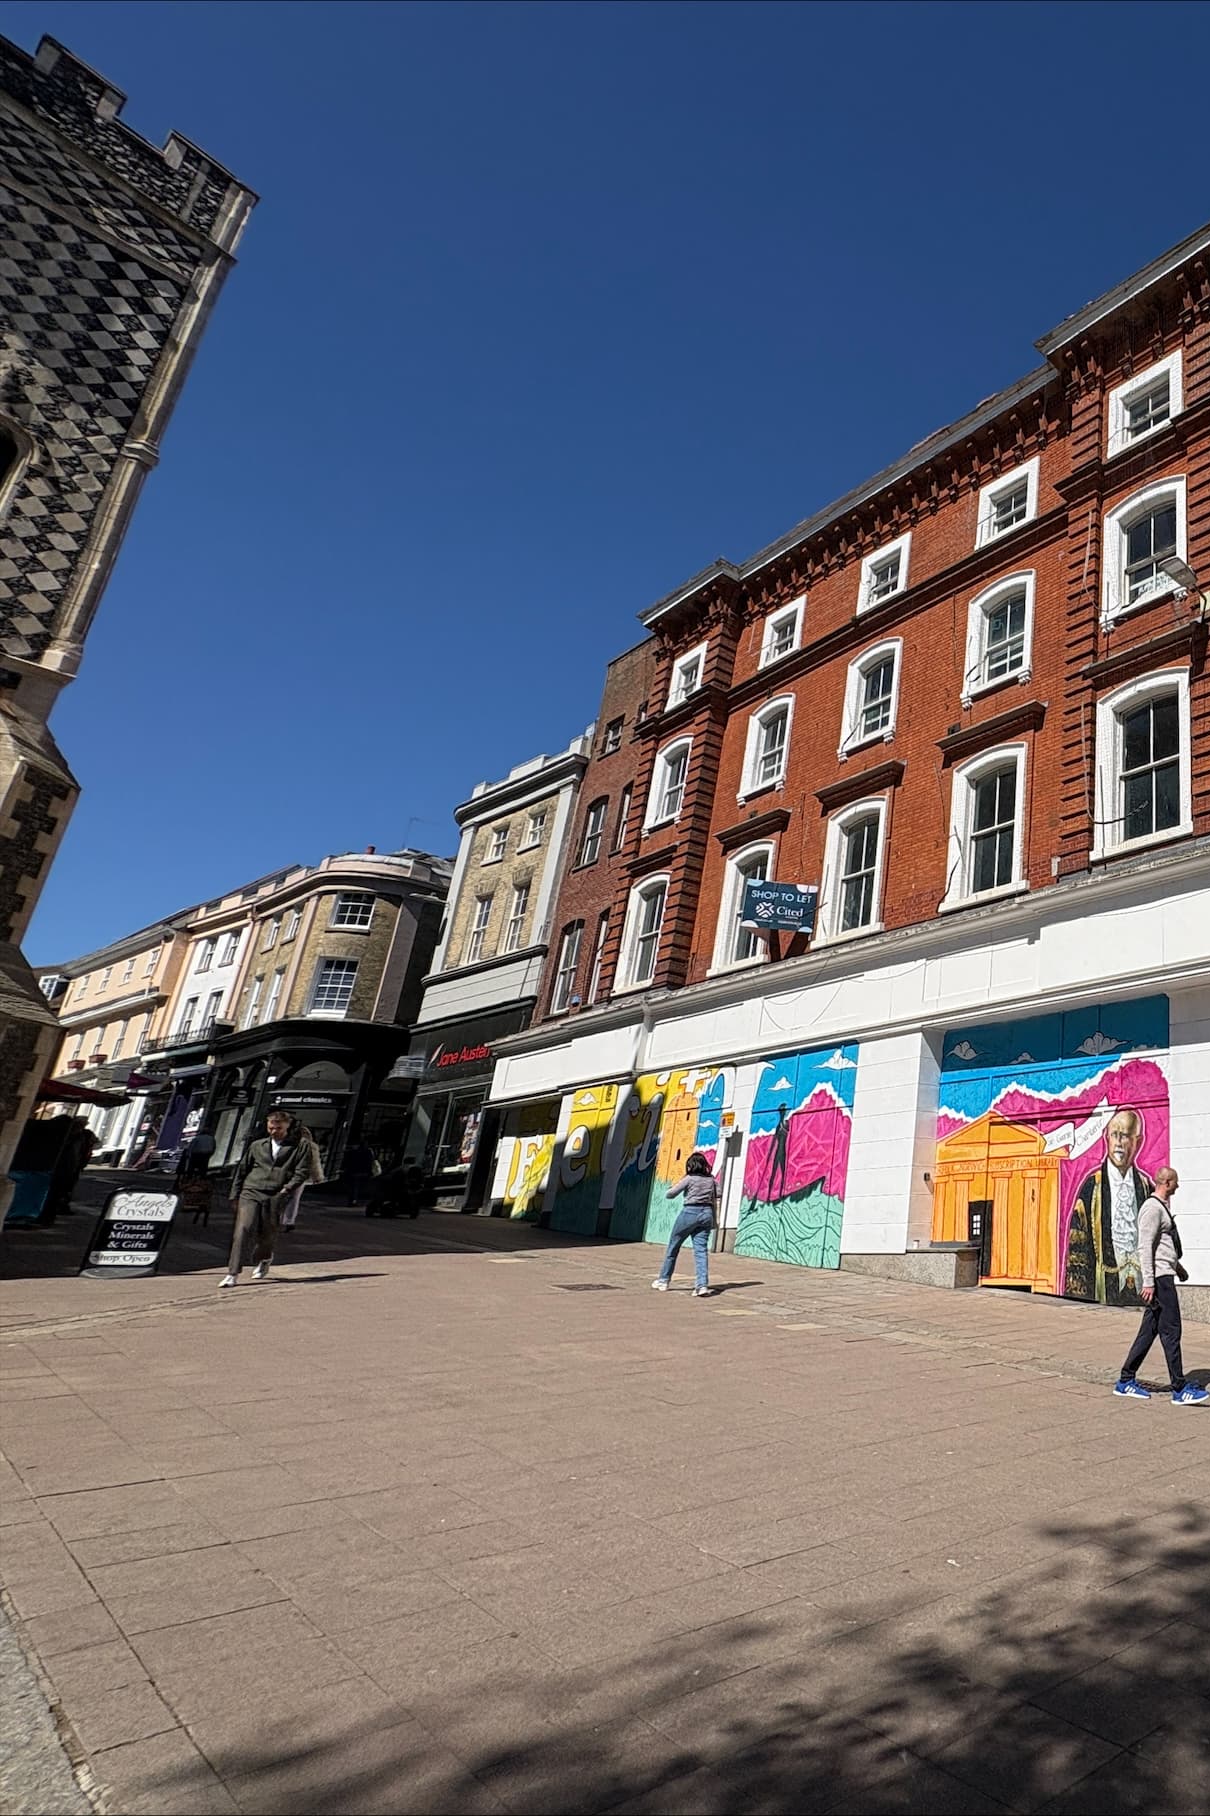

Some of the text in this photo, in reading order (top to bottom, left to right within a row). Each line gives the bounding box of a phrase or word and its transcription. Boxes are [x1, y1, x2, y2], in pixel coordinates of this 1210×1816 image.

[752, 890, 812, 904] SHOP TO LET
[776, 906, 804, 917] Cited
[437, 1050, 458, 1067] Jane
[117, 1205, 164, 1217] Crystals
[113, 1222, 154, 1232] Crystals
[108, 1231, 155, 1240] Minerals
[107, 1240, 148, 1249] & Gifts
[122, 1254, 150, 1264] Open
